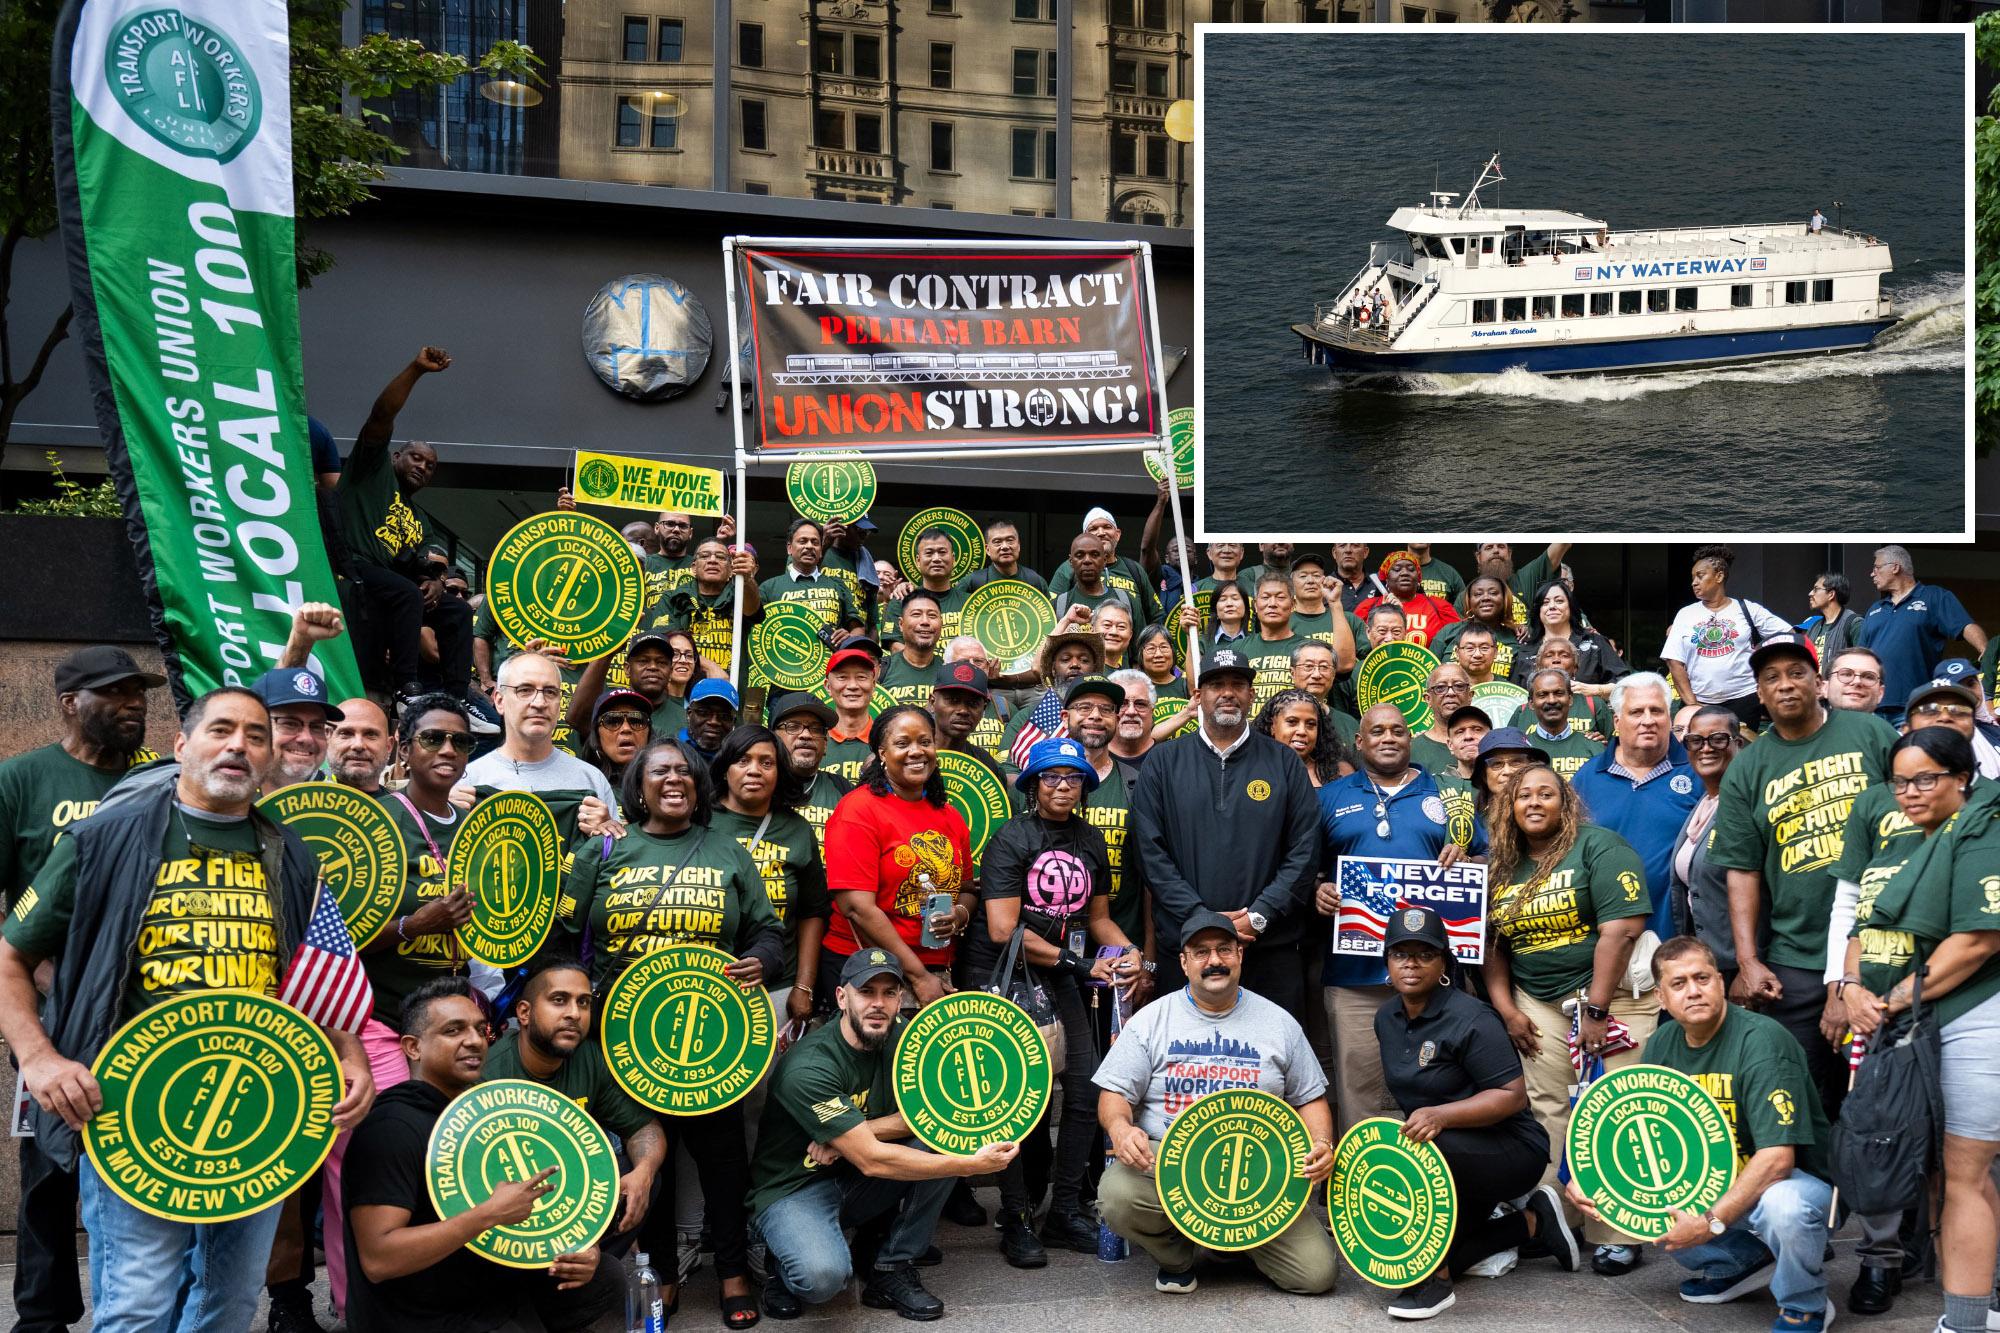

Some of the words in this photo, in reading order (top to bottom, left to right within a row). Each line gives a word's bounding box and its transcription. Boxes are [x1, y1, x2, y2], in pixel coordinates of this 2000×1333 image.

[116, 13, 181, 96] TRANSPORT
[184, 22, 250, 120] WORKERS
[188, 202, 263, 334] 100
[1597, 265, 1626, 279] NY
[1632, 259, 1747, 277] WATERWAY
[764, 270, 878, 307] FAIR
[889, 272, 1124, 310] CONTRACT
[146, 258, 199, 382] UNION
[819, 315, 971, 346] PELHAM
[983, 317, 1081, 344] BARN
[165, 397, 237, 581] WORKERS
[213, 367, 309, 613] LOCAL
[623, 465, 652, 484] WE
[658, 470, 711, 491] MOVE
[621, 485, 666, 504] NEW
[671, 490, 720, 510] YORK
[805, 507, 828, 521] MOVE
[849, 497, 868, 515] YORK
[908, 512, 943, 534] WORKERS
[945, 512, 969, 529] UNION
[558, 542, 592, 560] LOCAL
[902, 531, 922, 582] TRANSPORT
[972, 537, 981, 558] YORK
[501, 519, 575, 564] TRANSPORT
[580, 524, 635, 575] WORKERS
[618, 577, 639, 621] UNION
[495, 581, 511, 604] WE
[573, 631, 613, 655] YORK
[780, 606, 794, 614] WE
[986, 600, 1007, 613] LOCAL
[989, 585, 1034, 600] WORKERS
[1033, 596, 1051, 623] UNION
[753, 643, 769, 667] YORK
[1697, 645, 1735, 656] CARNIVAL
[775, 673, 801, 686] UNION
[1765, 768, 1804, 805] OUR
[1804, 752, 1863, 784] FIGHT
[981, 779, 1004, 819] UNION
[1768, 802, 1790, 823] OUR
[483, 827, 511, 848] LOCAL
[1776, 817, 1805, 843] OUR
[1805, 799, 1855, 831] FUTU
[275, 792, 379, 827] TRANSPORT
[371, 827, 397, 907] WORKERS
[335, 827, 364, 867] LOCAL
[454, 809, 493, 888] RANSPORT
[494, 798, 544, 827] WORKERS
[539, 824, 554, 872] UNION
[1781, 838, 1814, 872] OUR
[157, 859, 202, 886] UR
[207, 858, 266, 890] FIGH
[610, 867, 659, 889] OUR
[662, 865, 723, 887] FIGHT
[1381, 864, 1482, 884] NEVER
[171, 892, 272, 918] CONTRA
[606, 893, 634, 908] OUR
[1367, 882, 1482, 903] FORGET
[138, 923, 191, 955] OUR
[193, 921, 276, 951] FUTUR
[474, 938, 507, 959] MOVE
[509, 930, 534, 955] NEW
[530, 896, 551, 932] YORK
[607, 912, 644, 933] OUR
[647, 909, 723, 933] FUTURE
[140, 956, 202, 991] OUR
[666, 978, 705, 993] LOCAL
[707, 982, 727, 1002] 100
[612, 954, 681, 1022] TRANSPORT
[748, 995, 767, 1046] UNION
[902, 1011, 944, 1093] TRANSPORT
[945, 1000, 1016, 1025] WORKERS
[1012, 1022, 1042, 1067] UNION
[938, 1026, 973, 1048] LOCAL
[974, 1026, 994, 1040] 100
[104, 1001, 229, 1082] TRANSPORT
[235, 1002, 326, 1071] WORKERS
[302, 1072, 333, 1139] UNION
[199, 1036, 254, 1057] LOCAL
[256, 1048, 284, 1075] 100
[650, 1057, 679, 1077] EST.
[683, 1065, 715, 1081] 1934
[612, 1041, 634, 1069] WE
[626, 1072, 667, 1103] MOVE
[672, 1093, 710, 1107] NEW
[711, 1066, 754, 1099] YORK
[1167, 1064, 1261, 1082] TRANSPORT
[913, 1107, 934, 1135] WE
[934, 1130, 978, 1151] MOVE
[1011, 1087, 1042, 1126] YORK
[952, 1110, 980, 1125] EST.
[982, 1100, 1009, 1121] 1934
[1576, 1083, 1614, 1171] TRANSPORT
[1614, 1073, 1690, 1099] WORKERS
[1687, 1093, 1724, 1145] UNION
[1608, 1099, 1646, 1125] LOCAL
[1647, 1099, 1669, 1116] 100
[96, 1110, 123, 1149] WE
[434, 1098, 479, 1201] TRANSPORT
[477, 1088, 560, 1113] WORKERS
[561, 1108, 603, 1157] UNION
[475, 1118, 515, 1145] LOCAL
[517, 1117, 539, 1132] 100
[1165, 1097, 1227, 1168] TRANSPORT
[1231, 1096, 1296, 1134] WORKERS
[1213, 1121, 1250, 1135] LOCAL
[1250, 1124, 1270, 1140] 100
[1358, 1127, 1380, 1143] WE
[149, 1137, 186, 1170] EST.
[194, 1157, 241, 1175] 1934
[1338, 1139, 1362, 1170] MOVE
[106, 1145, 168, 1201] MOVE
[231, 1160, 296, 1203] YORK
[1334, 1171, 1345, 1208] NEW
[168, 1187, 226, 1211] NEW
[547, 1197, 576, 1222] 1934
[1204, 1198, 1229, 1217] EST.
[1233, 1201, 1261, 1217] 1934
[1592, 1187, 1616, 1216] WE
[1615, 1208, 1663, 1233] MOVE
[1694, 1166, 1728, 1215] YORK
[1632, 1189, 1663, 1206] EST.
[1664, 1179, 1693, 1202] 1934
[493, 1239, 547, 1259] MOVE
[552, 1222, 588, 1251] NEW
[586, 1179, 609, 1225] YORK
[1168, 1185, 1184, 1211] WE
[1180, 1212, 1221, 1243] MOVE
[1224, 1227, 1256, 1243] NEW
[1258, 1197, 1297, 1233] YORK
[1410, 1189, 1425, 1232] LOCAL
[1334, 1209, 1358, 1253] YORK
[1410, 1211, 1449, 1277] WORKERS
[1368, 1258, 1407, 1279] UNION
